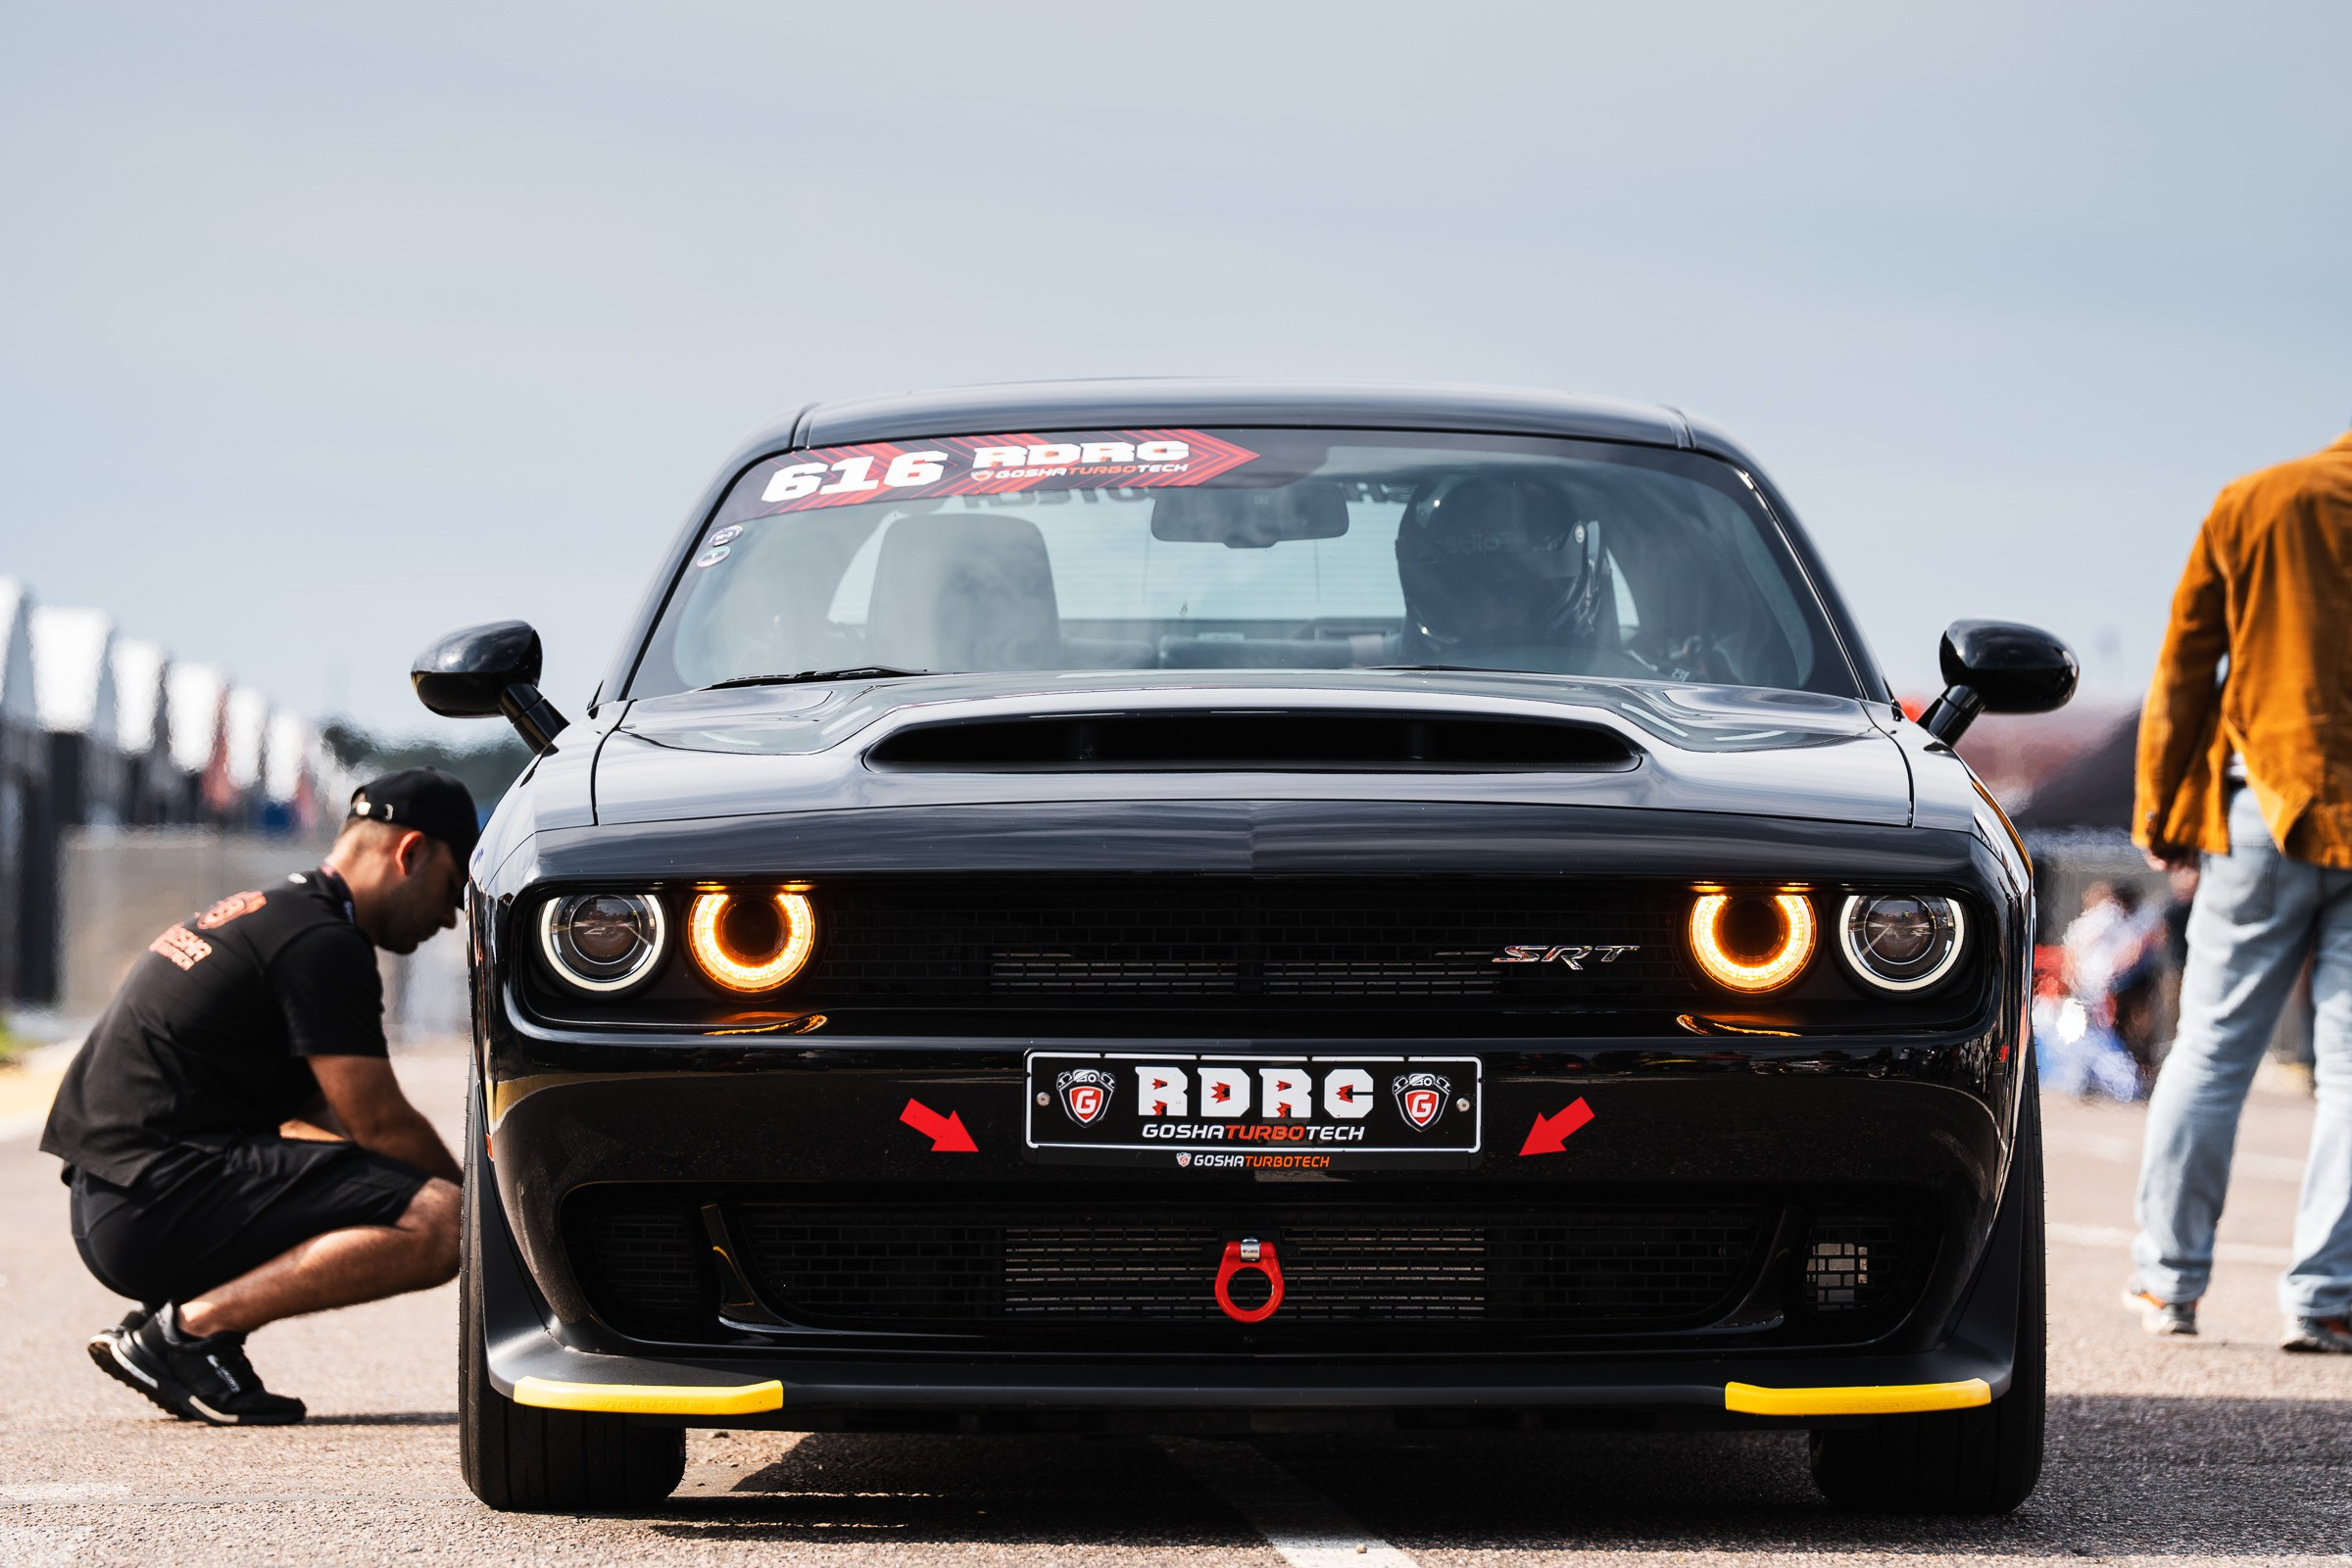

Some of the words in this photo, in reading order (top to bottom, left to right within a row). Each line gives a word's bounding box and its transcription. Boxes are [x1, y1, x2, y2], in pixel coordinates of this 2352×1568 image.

[972, 440, 1190, 468] RDRC
[760, 450, 949, 503] 616
[996, 464, 1189, 479] GOSHATURBOTECH
[1492, 945, 1641, 970] SRT
[1135, 1065, 1374, 1118] RDRC
[1142, 1123, 1365, 1141] GOSHATURBOTECH
[1194, 1154, 1331, 1168] GOSHATURBOTECH
